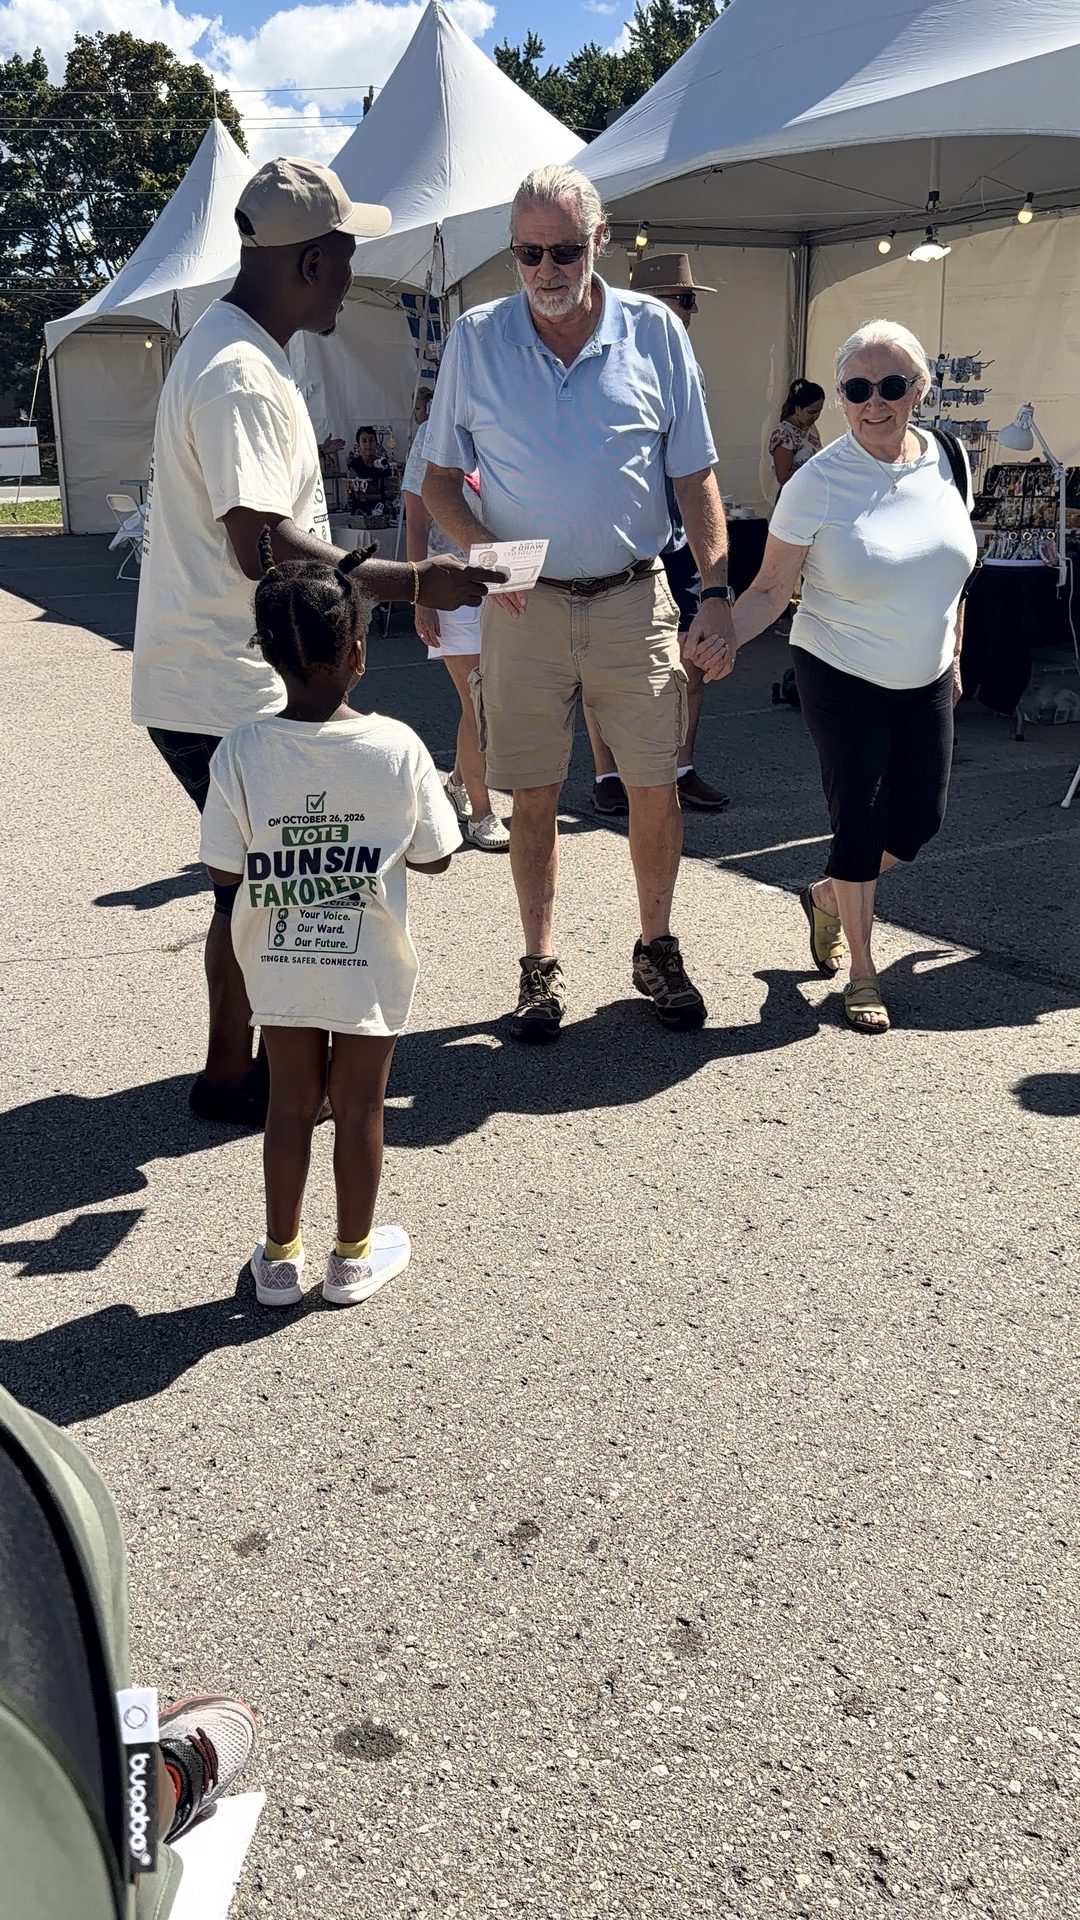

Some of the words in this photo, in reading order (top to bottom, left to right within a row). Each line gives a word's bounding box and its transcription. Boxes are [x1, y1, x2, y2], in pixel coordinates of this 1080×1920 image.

[268, 817, 281, 827] ON
[282, 815, 327, 824] OCTOBER
[329, 814, 343, 823] 26,
[344, 813, 366, 822] 2026
[288, 826, 343, 844] VOTE
[247, 846, 382, 881] DUNSIN
[300, 909, 320, 919] Your
[323, 911, 351, 921] Voice.
[297, 923, 314, 933] Our
[317, 924, 345, 934] Ward.
[294, 937, 312, 947] Our
[314, 938, 349, 949] Future.
[292, 956, 318, 965] SAFER.
[320, 957, 369, 967] CONNECTED.
